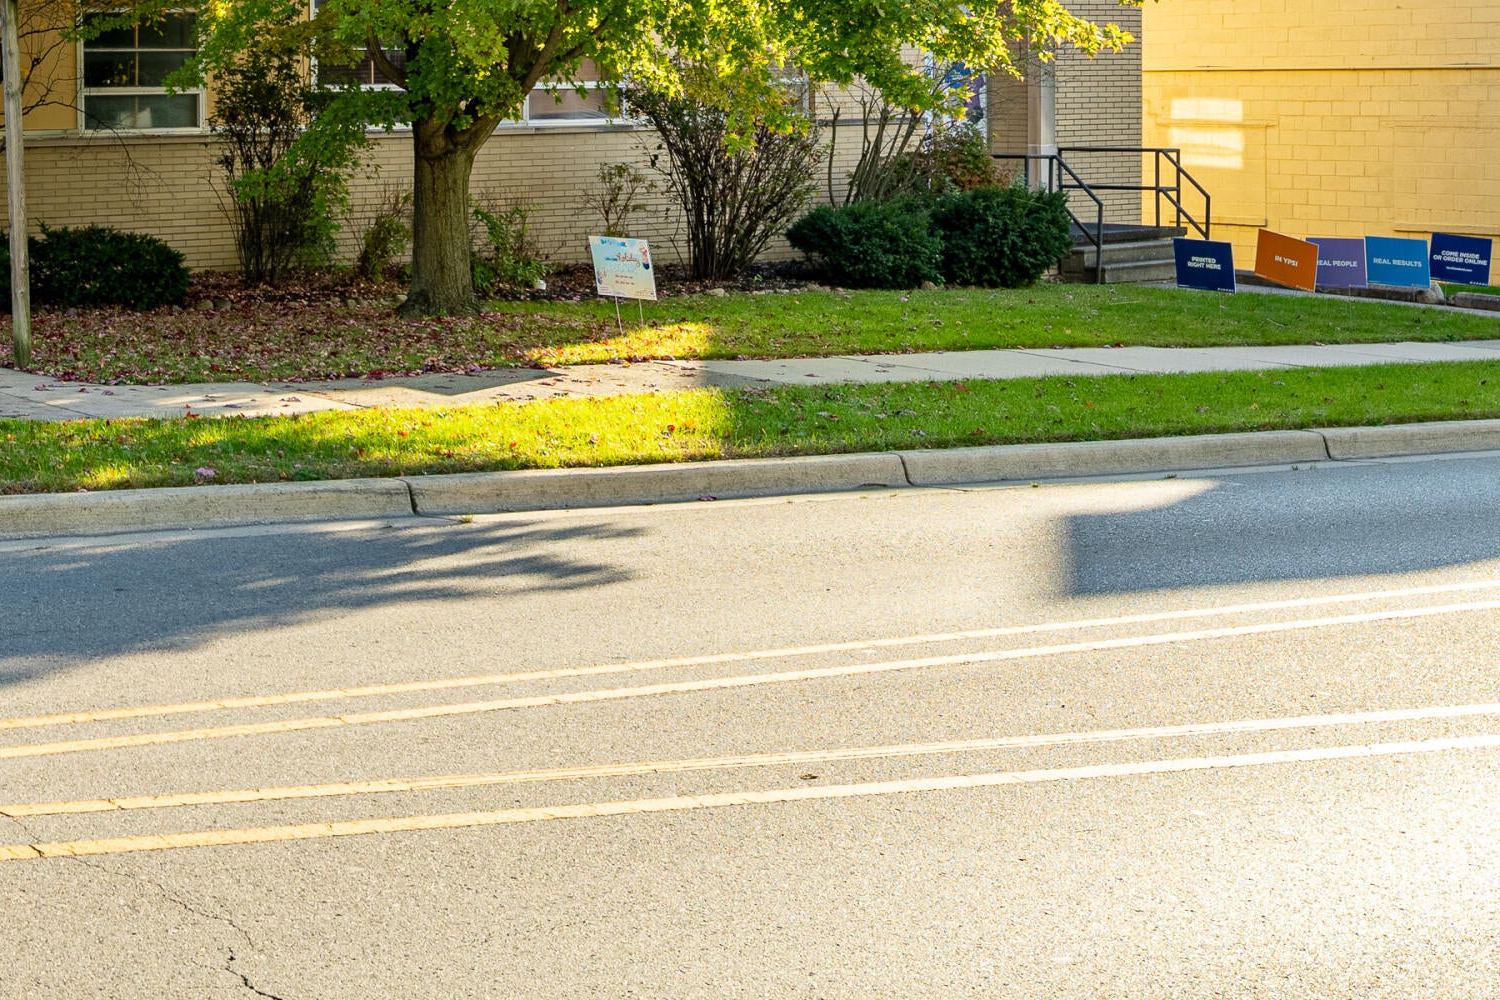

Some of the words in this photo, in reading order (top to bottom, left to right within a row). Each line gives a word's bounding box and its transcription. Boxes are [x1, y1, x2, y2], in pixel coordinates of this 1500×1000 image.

[1191, 256, 1217, 264] PRINTED
[1274, 255, 1283, 263] IN
[1460, 252, 1480, 260] INSIDE
[1316, 259, 1332, 267] EAL
[1332, 260, 1358, 268] PEOPLE
[1373, 257, 1391, 265] REAL
[1392, 259, 1422, 268] RESULTS
[1464, 258, 1488, 266] ONLINE
